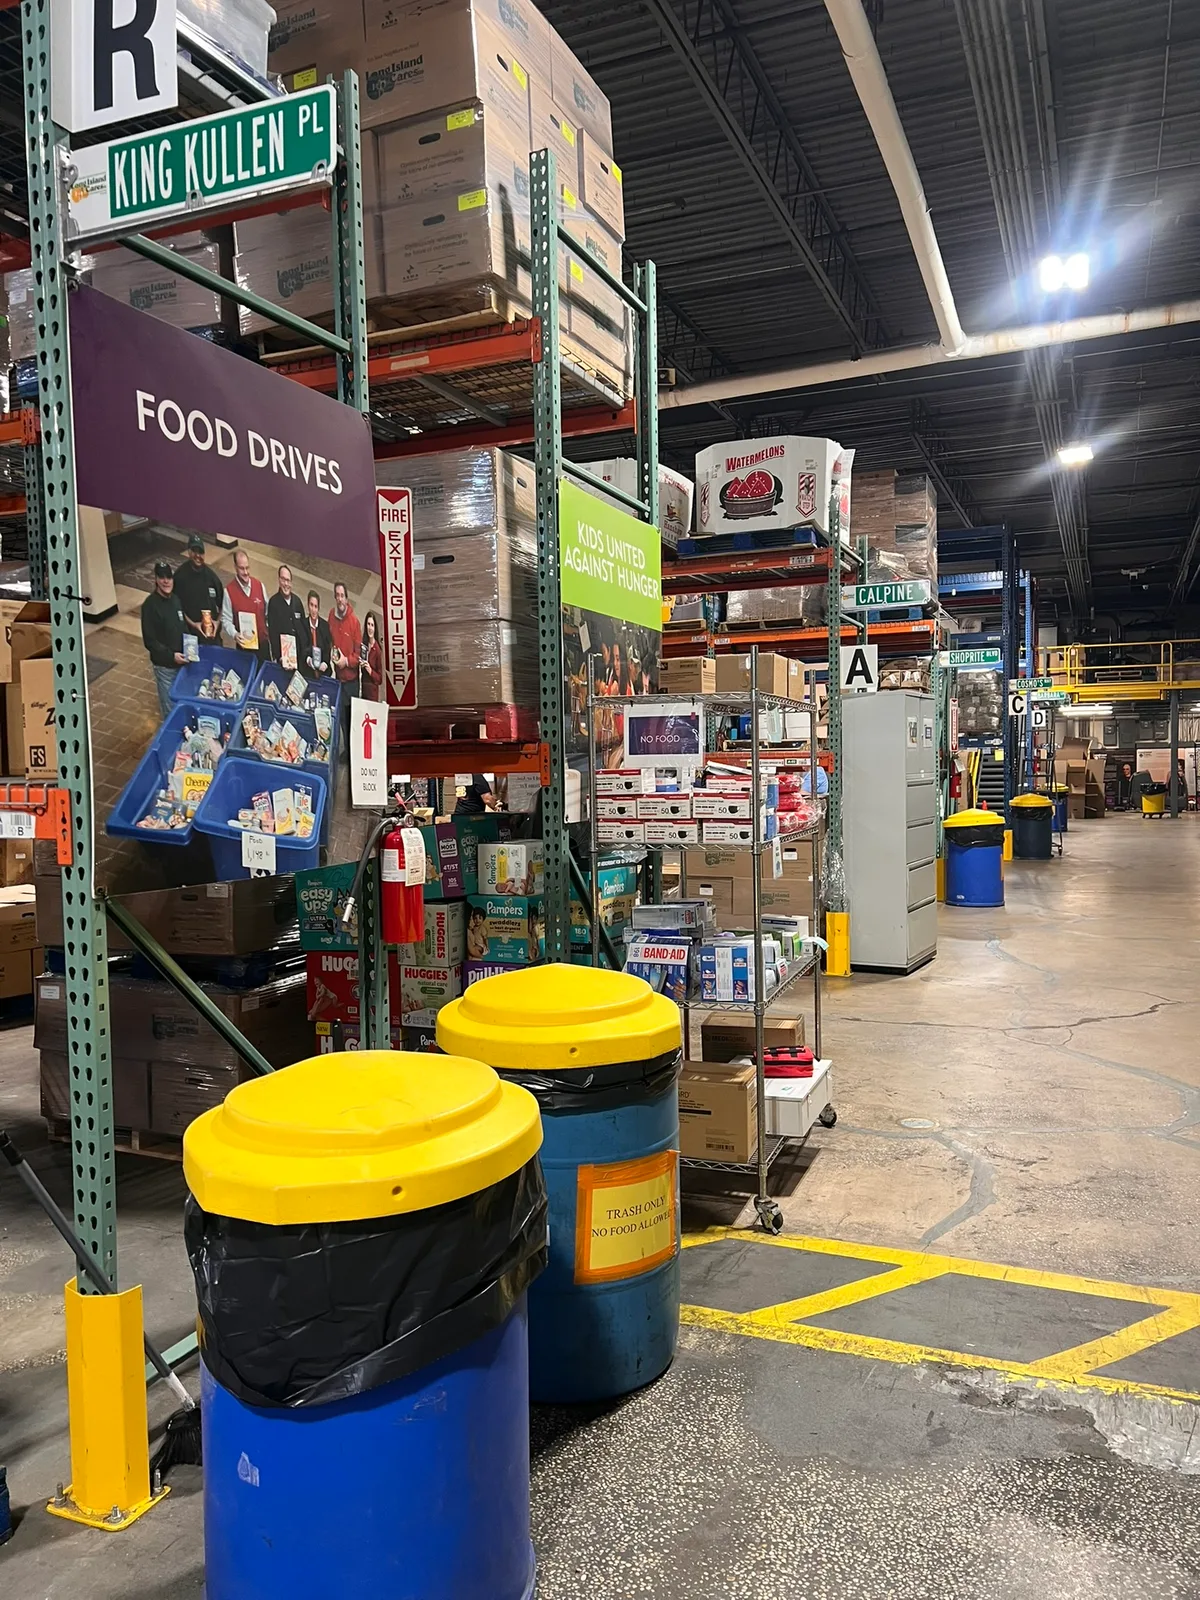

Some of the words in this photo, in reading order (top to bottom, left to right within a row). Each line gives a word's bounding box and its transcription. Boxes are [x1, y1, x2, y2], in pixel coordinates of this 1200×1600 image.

[93, 0, 160, 112] R
[391, 55, 423, 72] Island
[392, 69, 417, 82] Cares
[114, 138, 172, 210] KING
[185, 110, 284, 193] KULLEN
[298, 101, 323, 137] PL
[300, 256, 328, 271] Island
[136, 389, 238, 458] FOOD
[247, 429, 343, 495] DRIVES
[381, 508, 407, 523] FIRE
[577, 520, 604, 554] KIDS
[606, 534, 646, 570] UNITED
[564, 543, 614, 584] AGAINST
[617, 565, 660, 601] HUNGER
[859, 584, 914, 604] CALPINE
[388, 530, 406, 686] EXTINGUISHER
[950, 651, 985, 664] SHOPRITE
[845, 648, 874, 685] A
[1017, 679, 1044, 688] COSMO'S
[1011, 695, 1025, 714] C
[1034, 712, 1044, 725] D
[640, 735, 654, 743] NO
[655, 734, 681, 743] FOOD
[31, 748, 46, 765] FS
[360, 768, 368, 777] DO
[368, 768, 378, 777] NOT
[363, 782, 377, 792] BLOCK
[18, 827, 24, 836] B
[461, 835, 479, 847] easy
[463, 846, 477, 859] ups
[488, 854, 497, 885] Pampers
[300, 889, 333, 902] easy
[603, 880, 625, 896] Pampers
[304, 900, 328, 914] ups
[487, 901, 523, 916] Pampers
[578, 907, 584, 915] 2
[436, 912, 446, 959] HUGGIES
[518, 947, 524, 955] 4
[643, 947, 686, 960] BAND-AID
[404, 967, 448, 981] HUGGIES
[606, 1204, 643, 1220] TRASH
[644, 1195, 666, 1213] ONLY
[592, 1228, 608, 1238] NO
[610, 1223, 637, 1237] FOOD
